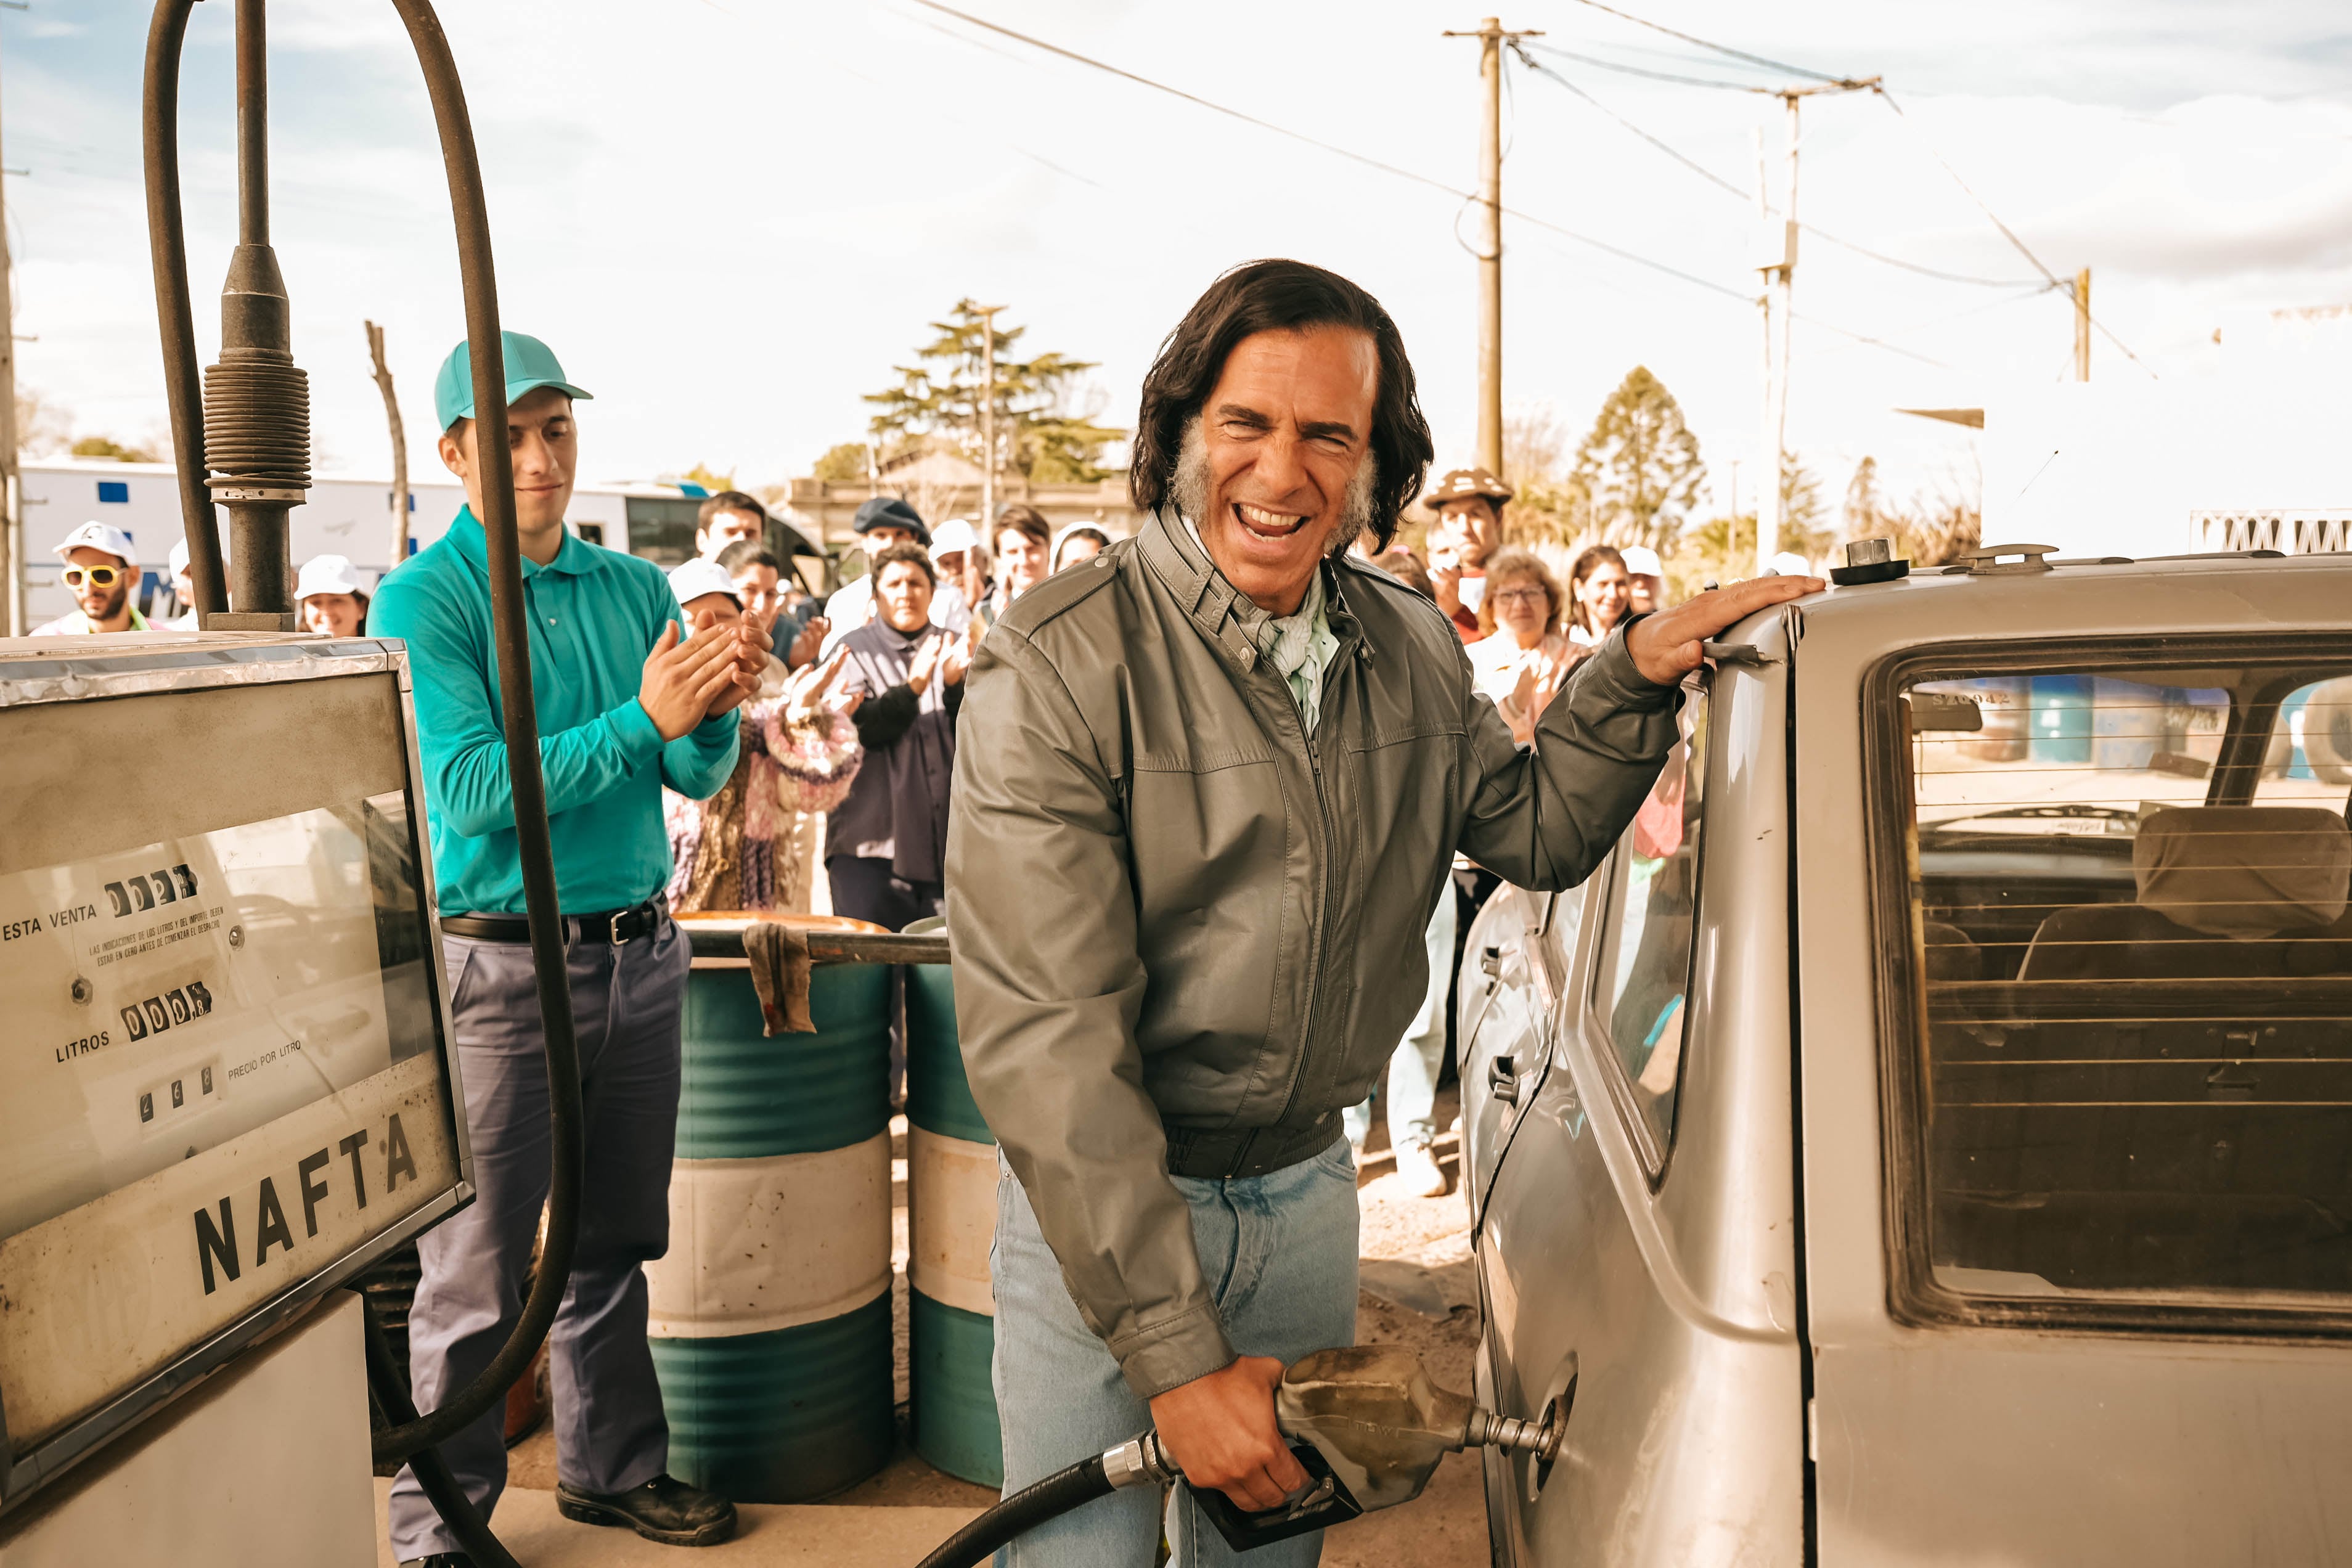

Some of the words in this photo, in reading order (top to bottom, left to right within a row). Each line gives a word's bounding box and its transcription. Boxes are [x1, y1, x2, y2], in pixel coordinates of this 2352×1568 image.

[2, 918, 42, 941] ESTA
[49, 904, 97, 928] VENTA
[89, 944, 100, 956] LAS
[102, 933, 136, 952] INDICACIONES
[138, 931, 145, 941] DE
[147, 926, 155, 937] LOS
[157, 921, 174, 934] LITROS
[175, 920, 179, 929] Y
[180, 917, 189, 928] DEL
[189, 910, 208, 924] IMPORTE
[210, 905, 224, 918] DEBEN
[97, 954, 114, 967] ESTAR
[116, 951, 123, 961] EN
[125, 945, 138, 958] CERO
[139, 941, 155, 954] ANTES
[157, 938, 164, 947] DE
[165, 928, 190, 944] COMENZAR
[190, 926, 197, 937] EL
[197, 919, 221, 934] DESPACHO
[55, 1031, 110, 1063] LITROS
[228, 1059, 258, 1080] PRECIO
[259, 1050, 277, 1066] POR
[280, 1039, 301, 1058] LITRO
[194, 1112, 418, 1296] NAFTA
